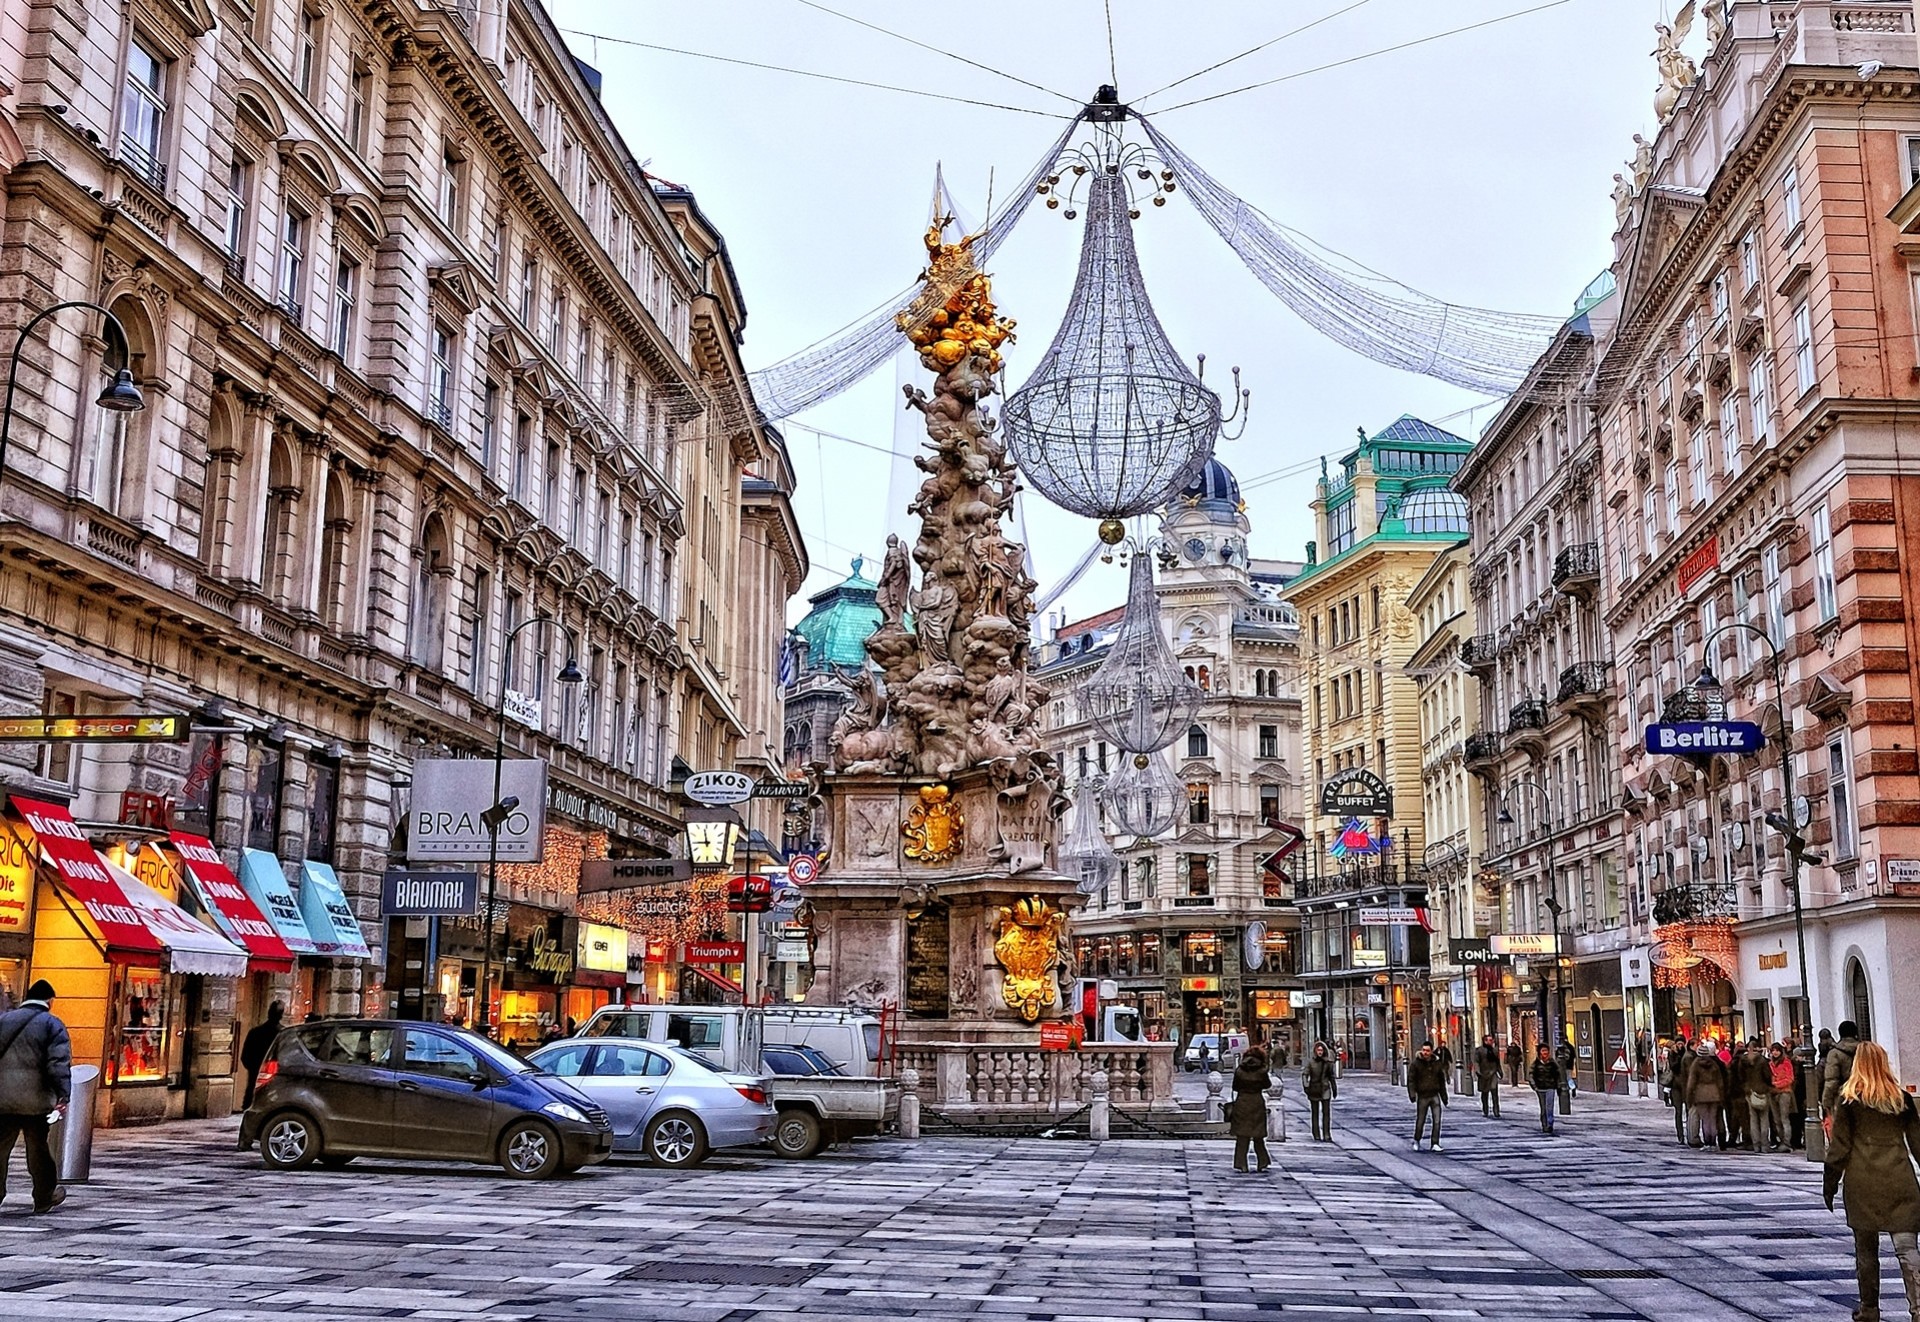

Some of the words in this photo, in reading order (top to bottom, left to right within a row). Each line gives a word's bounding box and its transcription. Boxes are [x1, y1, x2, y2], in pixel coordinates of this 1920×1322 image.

[1660, 726, 1744, 747] Berlitz
[693, 774, 747, 789] ZIKOS
[759, 786, 806, 796] KEARNEY
[1337, 797, 1374, 806] BUFFET
[589, 799, 616, 830] HÜBNER
[59, 858, 109, 883] BOOKS
[141, 858, 179, 891] FRICK
[613, 865, 674, 877] HÜBNER
[1509, 935, 1542, 945] HABAN
[690, 945, 732, 959] Triumph
